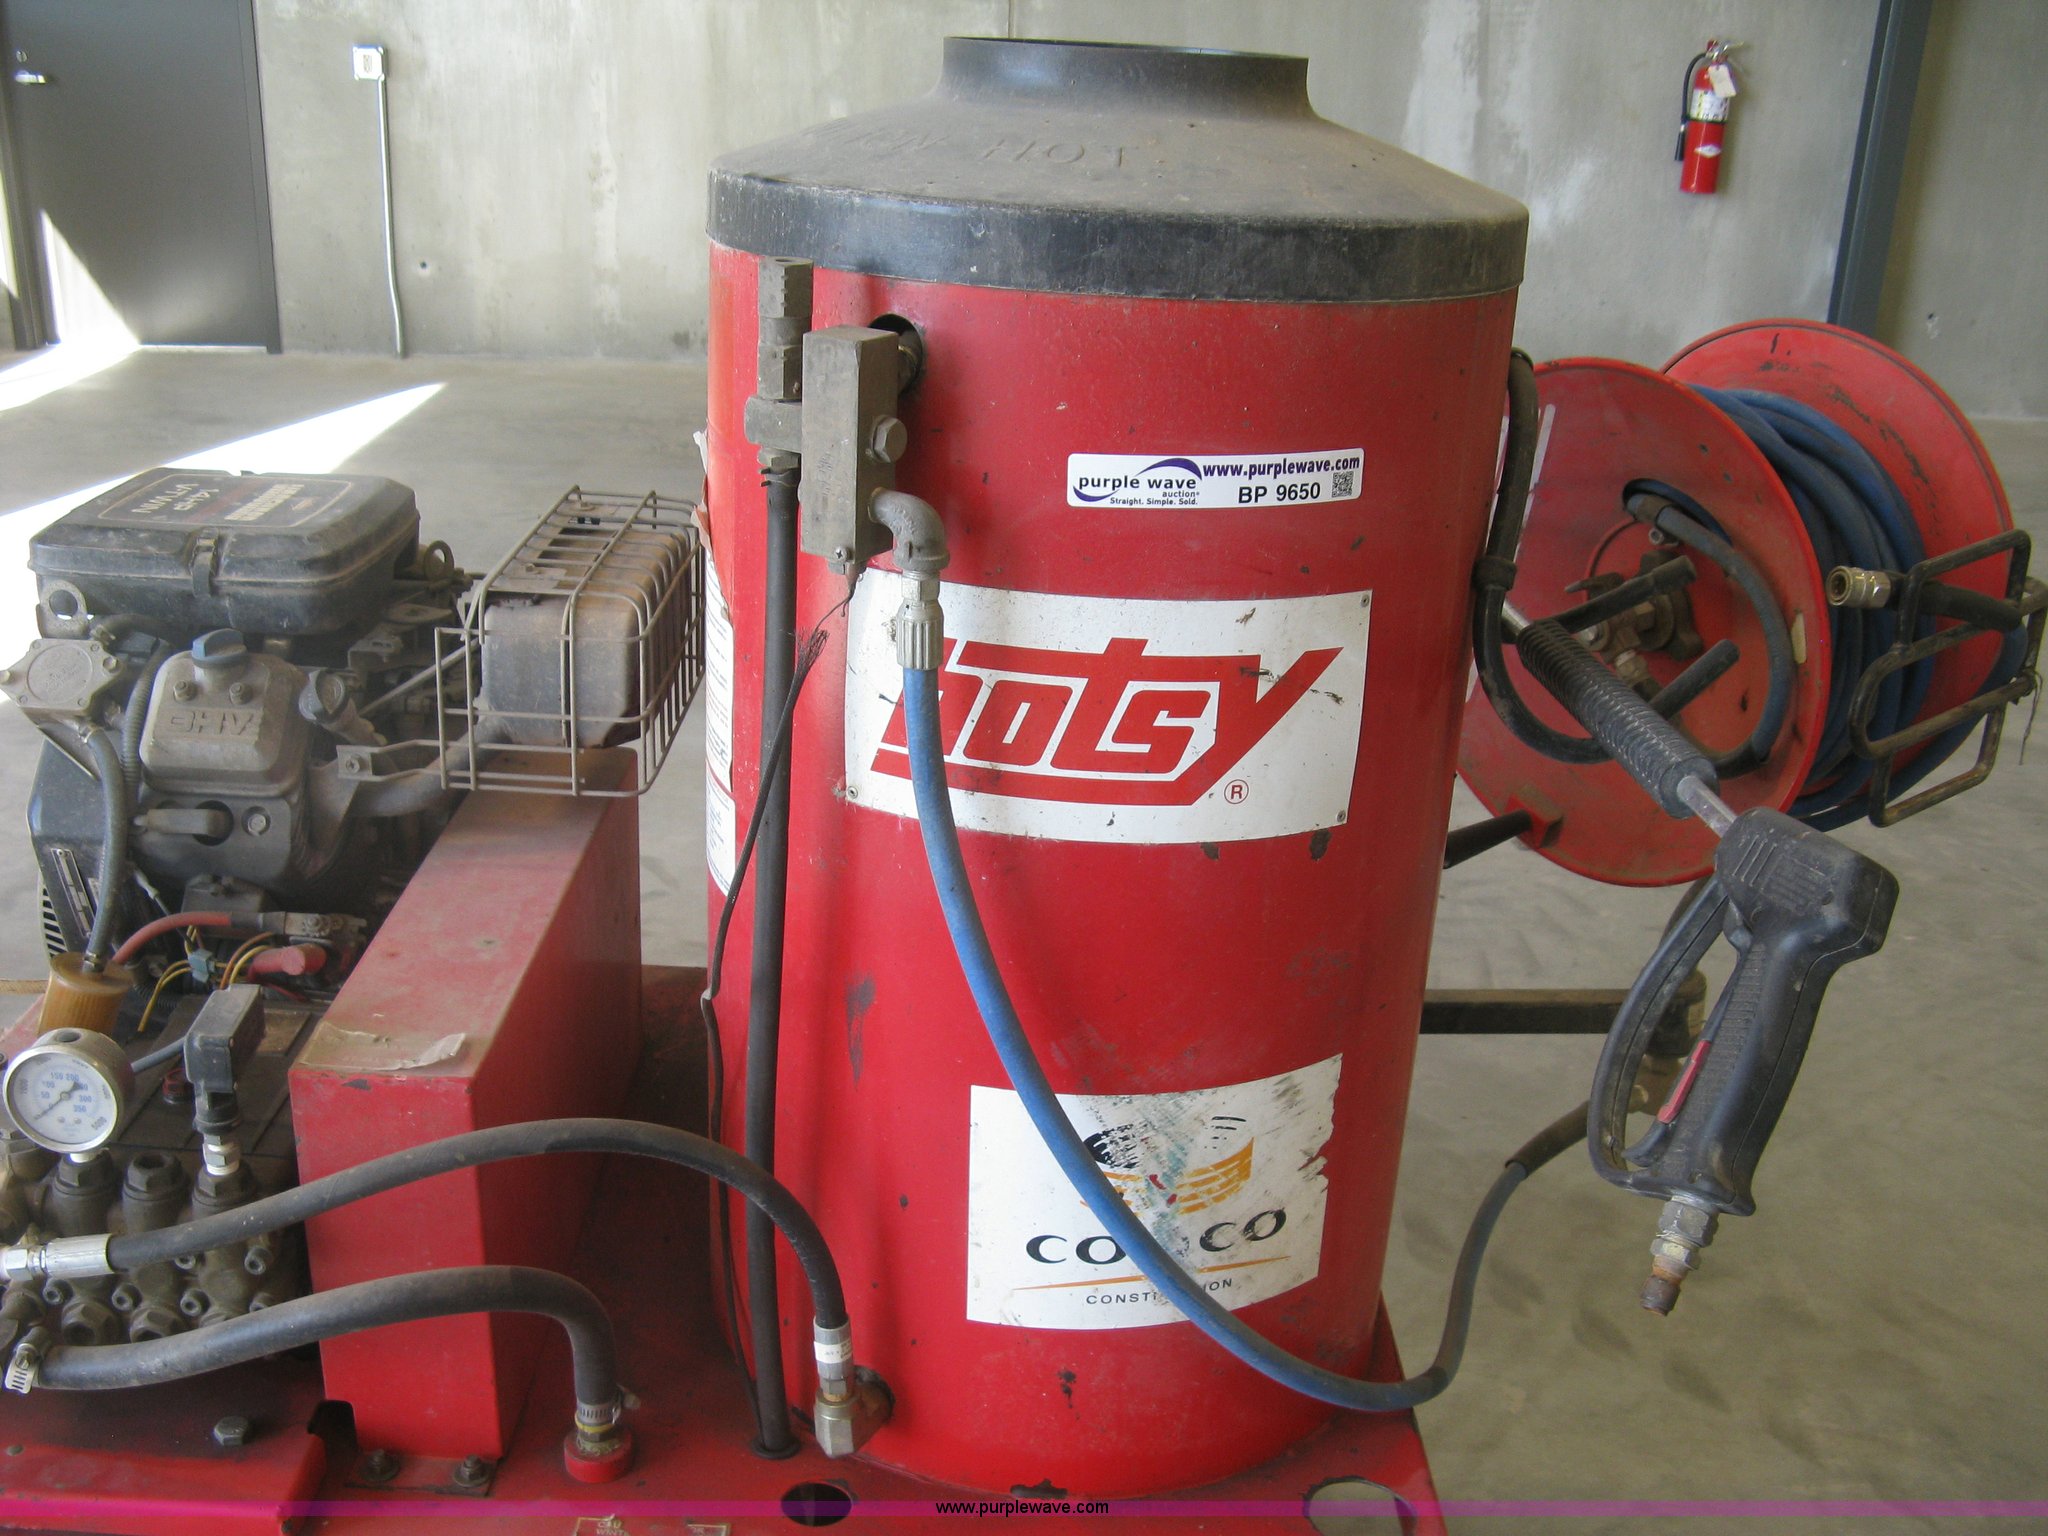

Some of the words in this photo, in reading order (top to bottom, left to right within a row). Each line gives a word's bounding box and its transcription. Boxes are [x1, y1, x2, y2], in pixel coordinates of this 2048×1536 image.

[980, 138, 1140, 169] HOT
[1202, 456, 1360, 480] www.purplewave.com
[1079, 475, 1140, 491] purple
[1148, 479, 1197, 489] wave
[1238, 486, 1268, 504] BP
[1276, 482, 1321, 502] 9650
[1110, 497, 1144, 506] Straight.
[1146, 497, 1176, 506] Simple.
[1178, 497, 1198, 505] Sold.
[1025, 1207, 1287, 1265] COCO
